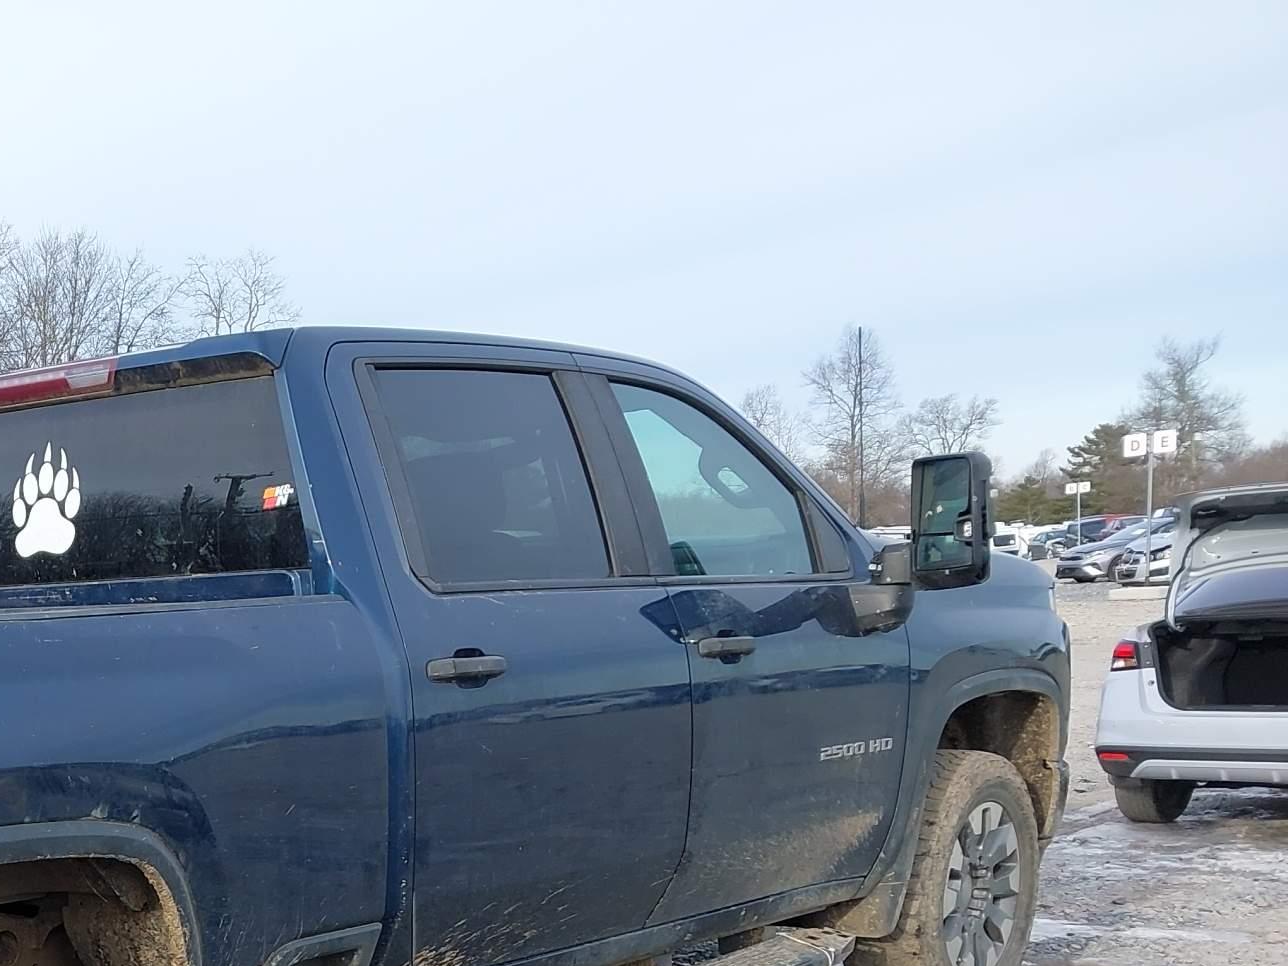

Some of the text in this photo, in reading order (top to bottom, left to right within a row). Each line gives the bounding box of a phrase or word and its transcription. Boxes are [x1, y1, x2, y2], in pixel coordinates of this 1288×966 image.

[1130, 435, 1169, 452] D E
[820, 737, 893, 761] 2500 HD
